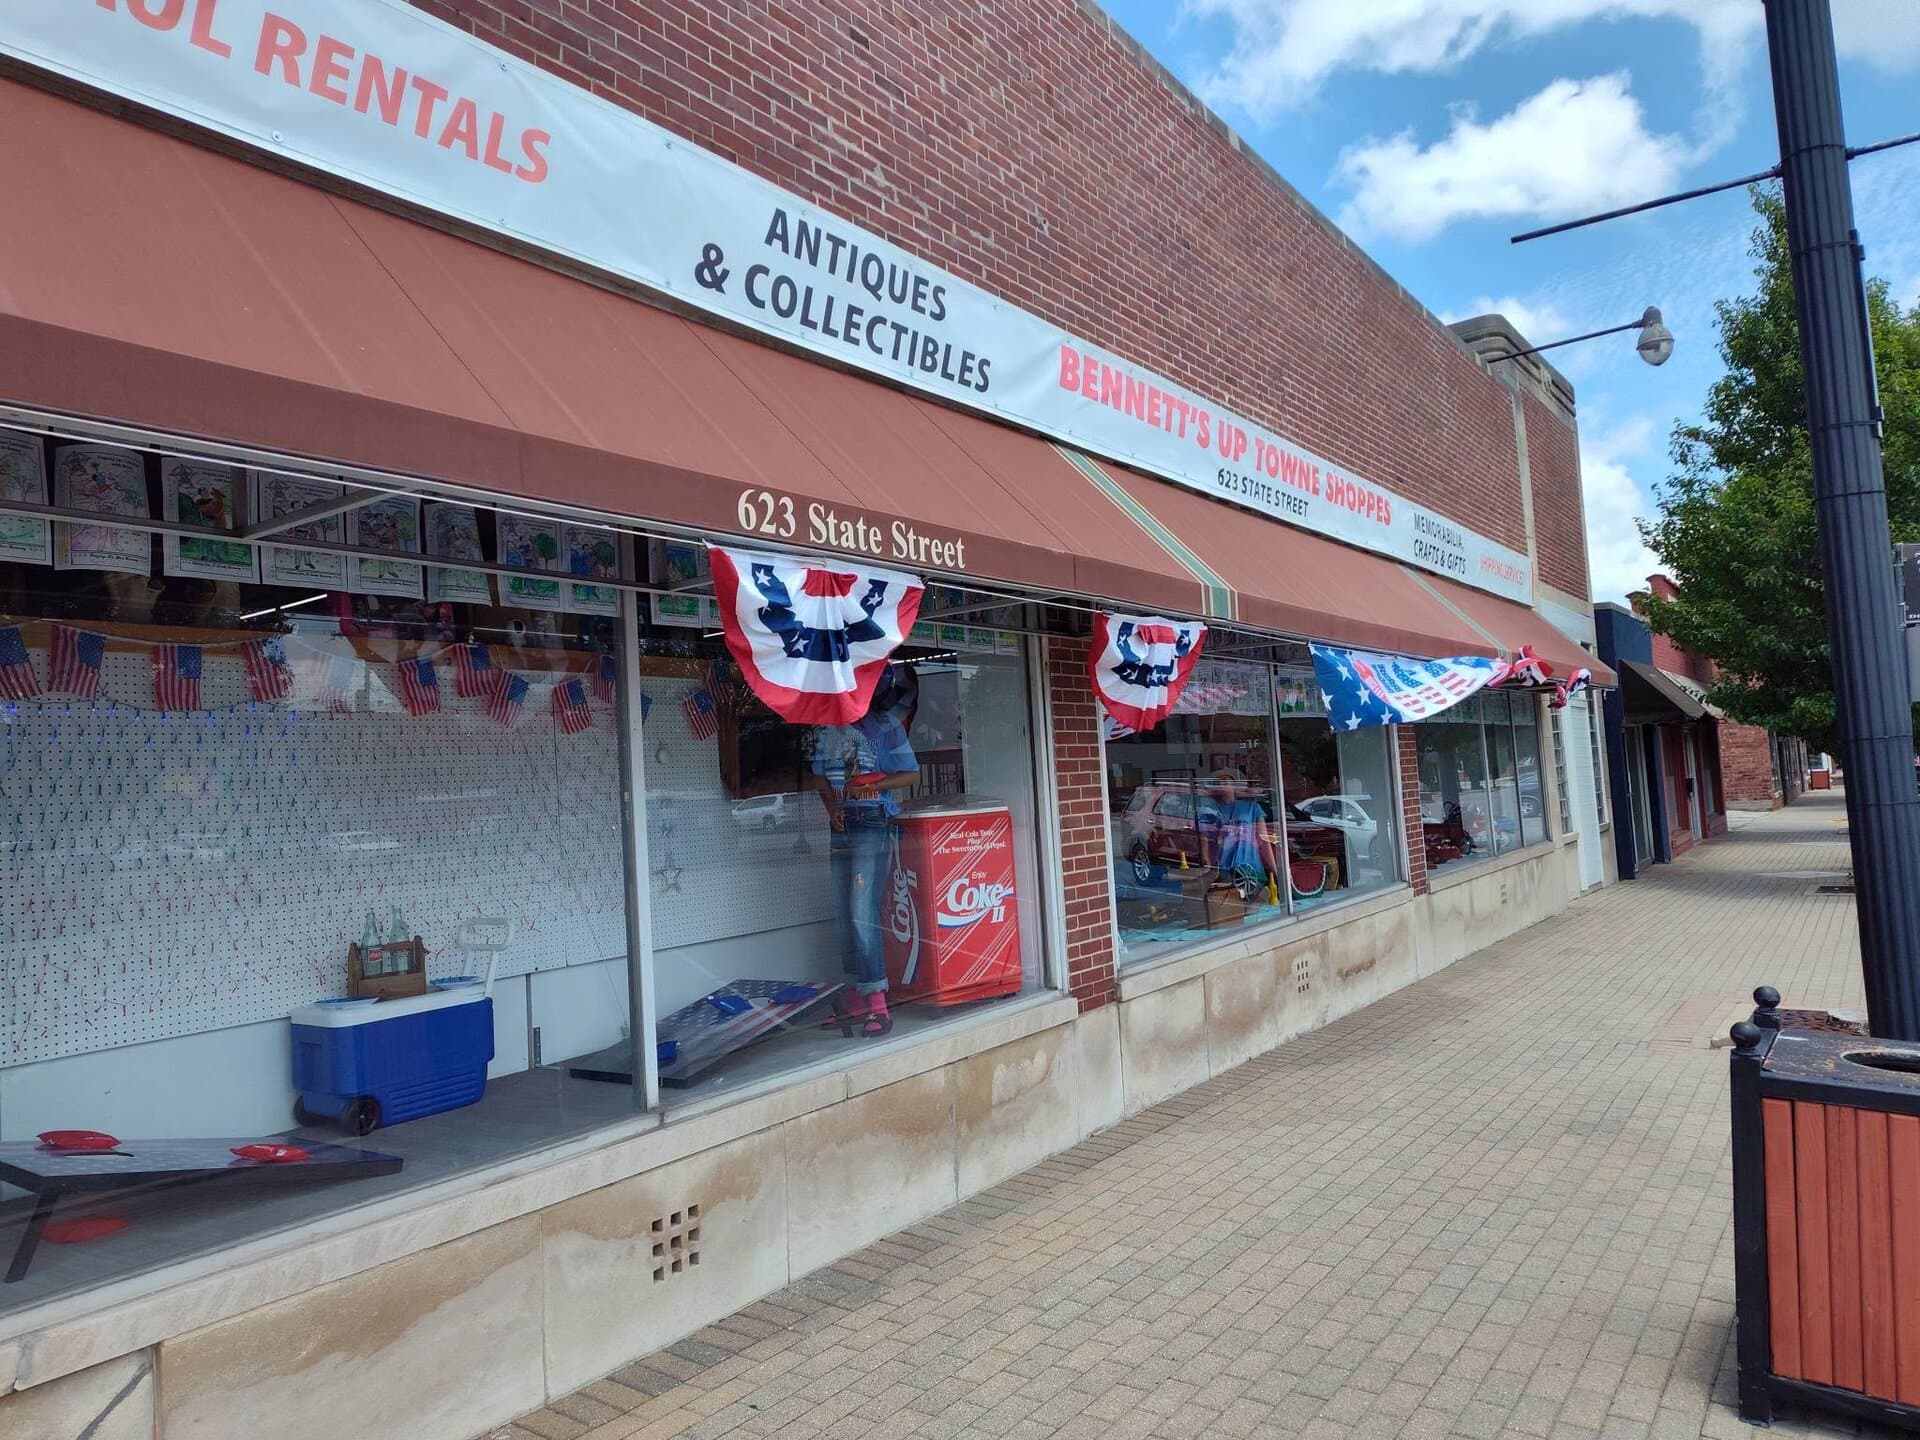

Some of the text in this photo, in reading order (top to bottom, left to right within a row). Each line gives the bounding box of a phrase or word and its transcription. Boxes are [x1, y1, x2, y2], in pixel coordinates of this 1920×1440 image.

[254, 11, 551, 184] RENTALS
[764, 207, 947, 322] ANTIQUES
[694, 242, 992, 393] & COLLECTIBLES
[1059, 344, 1391, 526] BENNETT'S UP TOWNE SHOPPES
[738, 489, 966, 568] 623 State Street
[1217, 468, 1309, 517] 623 STATE STREET
[1414, 538, 1466, 575] CRAFTS & GIFTS
[891, 864, 910, 942] Coke
[947, 877, 1013, 912] Coke
